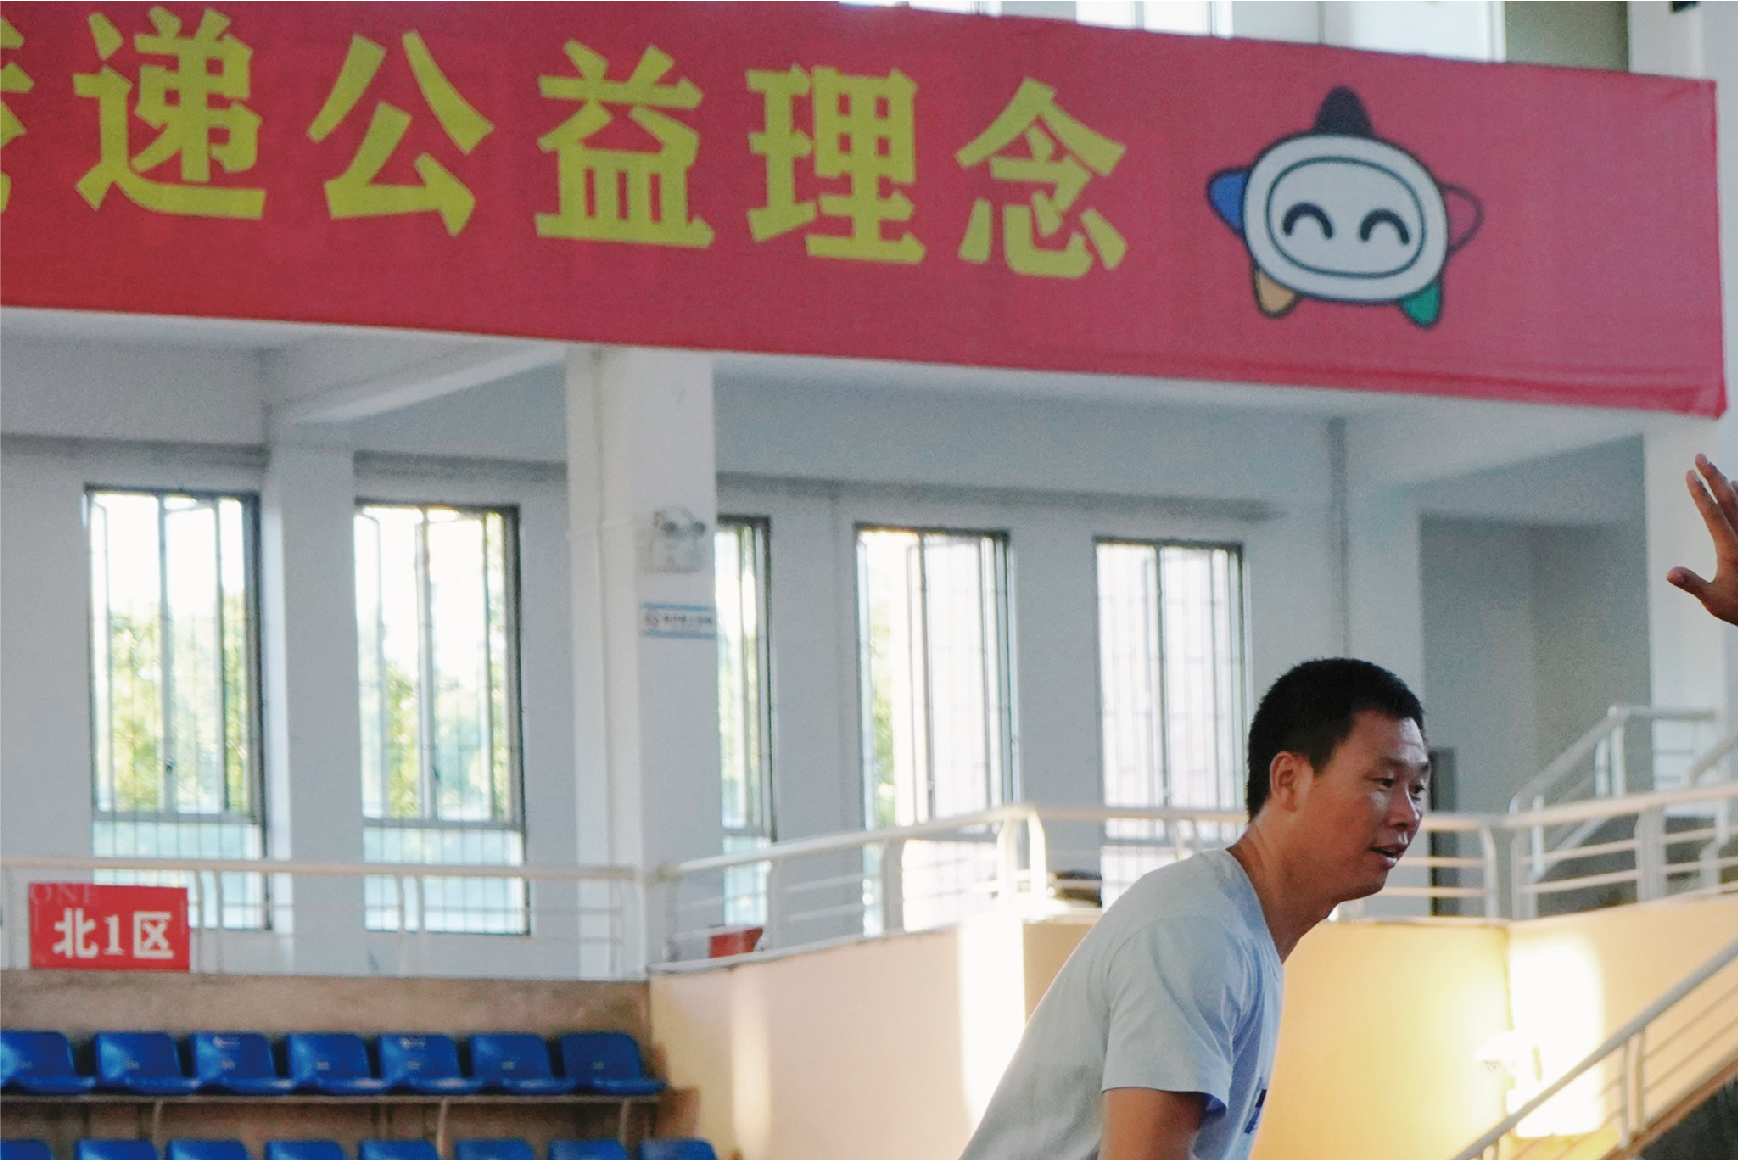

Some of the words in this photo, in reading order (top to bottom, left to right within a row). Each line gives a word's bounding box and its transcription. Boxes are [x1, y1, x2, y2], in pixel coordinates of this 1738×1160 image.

[0, 7, 1127, 278] 递公益理念
[52, 908, 174, 959] 北1区
